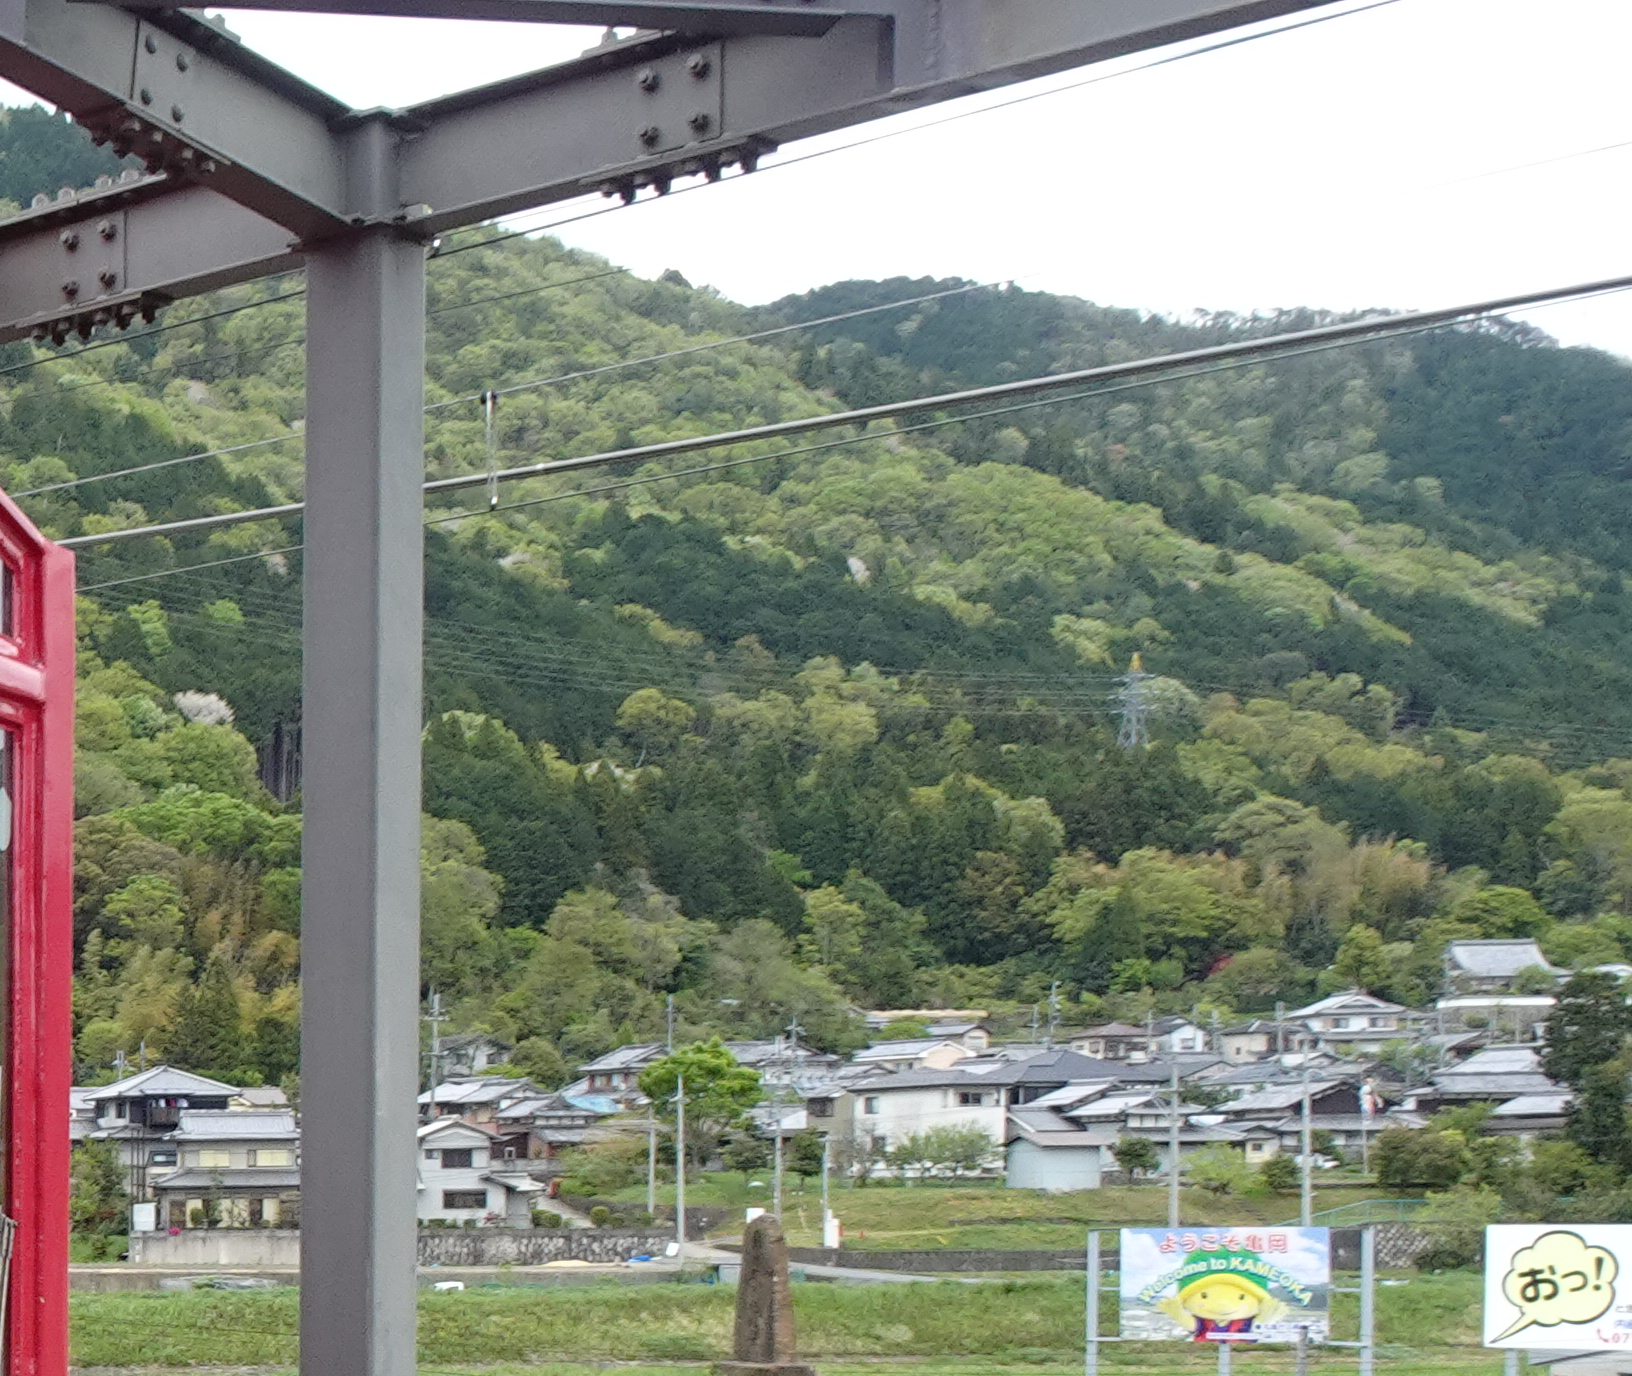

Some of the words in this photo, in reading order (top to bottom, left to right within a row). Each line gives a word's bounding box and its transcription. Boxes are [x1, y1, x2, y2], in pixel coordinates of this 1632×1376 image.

[1159, 1232, 1289, 1253] ようこそ亀岡
[1136, 1259, 1208, 1304] Welcome
[1210, 1256, 1227, 1270] to
[1229, 1256, 1314, 1307] KAMEOKA
